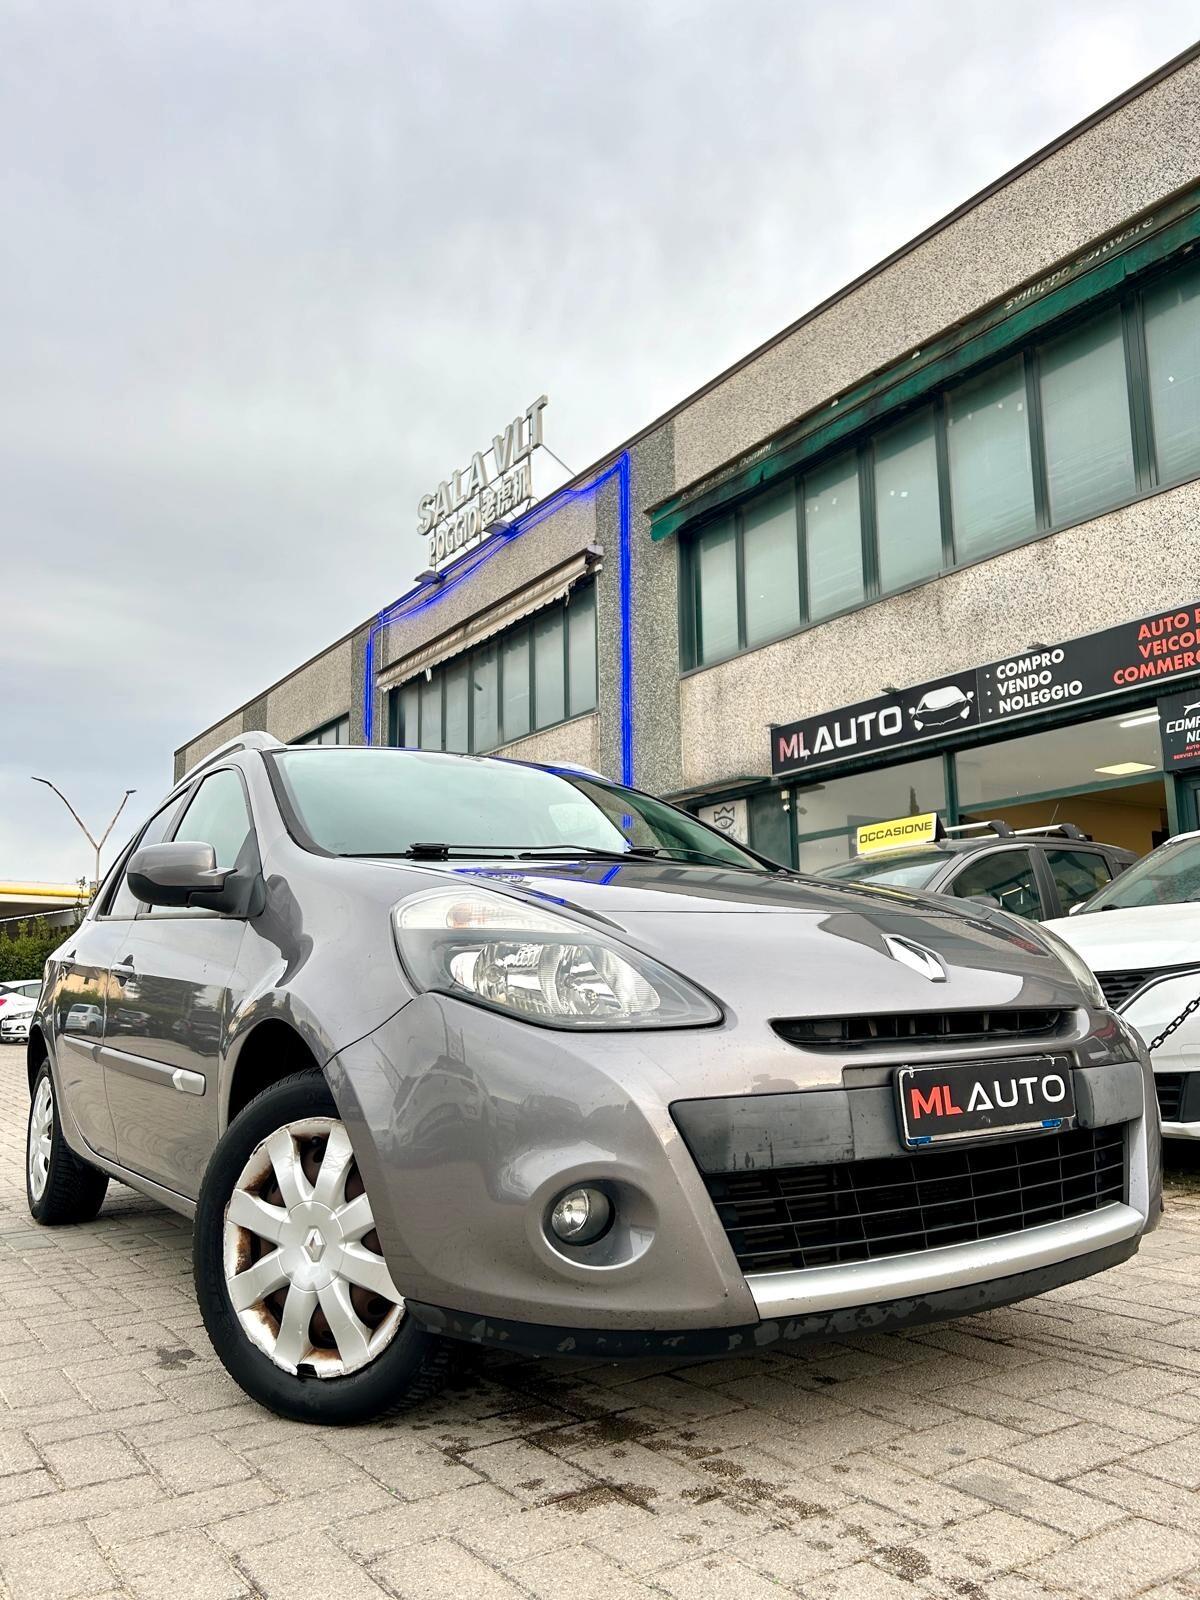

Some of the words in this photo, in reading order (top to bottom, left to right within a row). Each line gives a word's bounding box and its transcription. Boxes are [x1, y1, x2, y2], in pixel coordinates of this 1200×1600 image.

[1004, 267, 1070, 310] Sviluppo
[416, 451, 488, 535] SALA
[492, 394, 549, 476] VLT
[428, 506, 481, 566] POGGIO
[1137, 612, 1190, 641] AUTO
[996, 648, 1065, 680] COMPRO
[997, 670, 1052, 697] VENDO
[998, 680, 1083, 714] NOLEGGIO
[779, 731, 811, 763] ML
[813, 705, 902, 754] AUTO
[859, 821, 933, 844] OCCASIONE
[911, 1085, 963, 1119] ML
[967, 1074, 1066, 1112] AUTO
